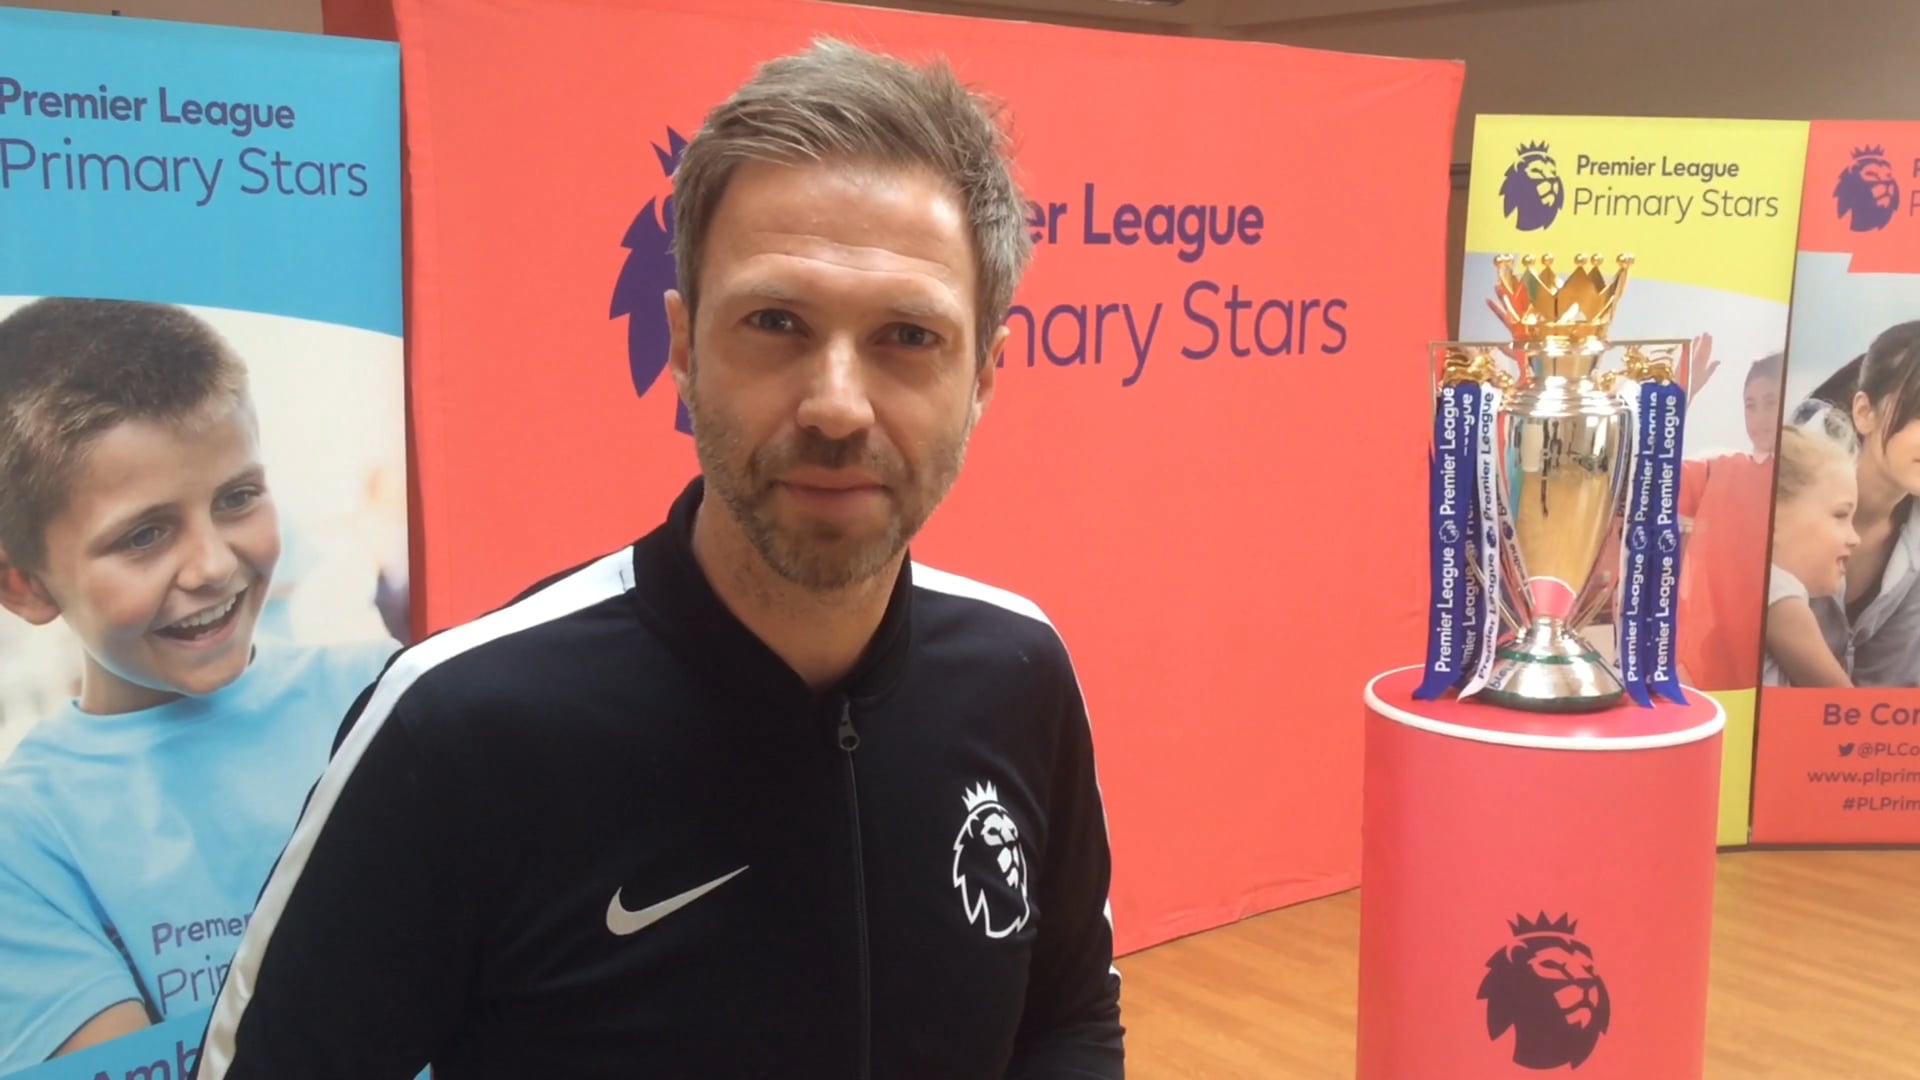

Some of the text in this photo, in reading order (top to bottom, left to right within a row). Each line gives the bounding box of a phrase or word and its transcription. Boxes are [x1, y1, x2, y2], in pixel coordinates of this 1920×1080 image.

[0, 77, 295, 137] Premier League
[0, 137, 367, 206] Primary Stars
[1576, 154, 1740, 183] Premier League
[1083, 183, 1264, 263] League
[1573, 186, 1779, 224] Primary Stars
[1181, 280, 1348, 361] Stars
[1481, 392, 1495, 454] League
[1481, 460, 1494, 521] Premier
[1634, 459, 1653, 522] Premier
[1434, 387, 1460, 673] Premier League Premier League
[1654, 395, 1680, 682] Premier League Premier League
[1626, 553, 1645, 616] League
[1625, 620, 1639, 682] Premier
[1823, 703, 1861, 726] Be
